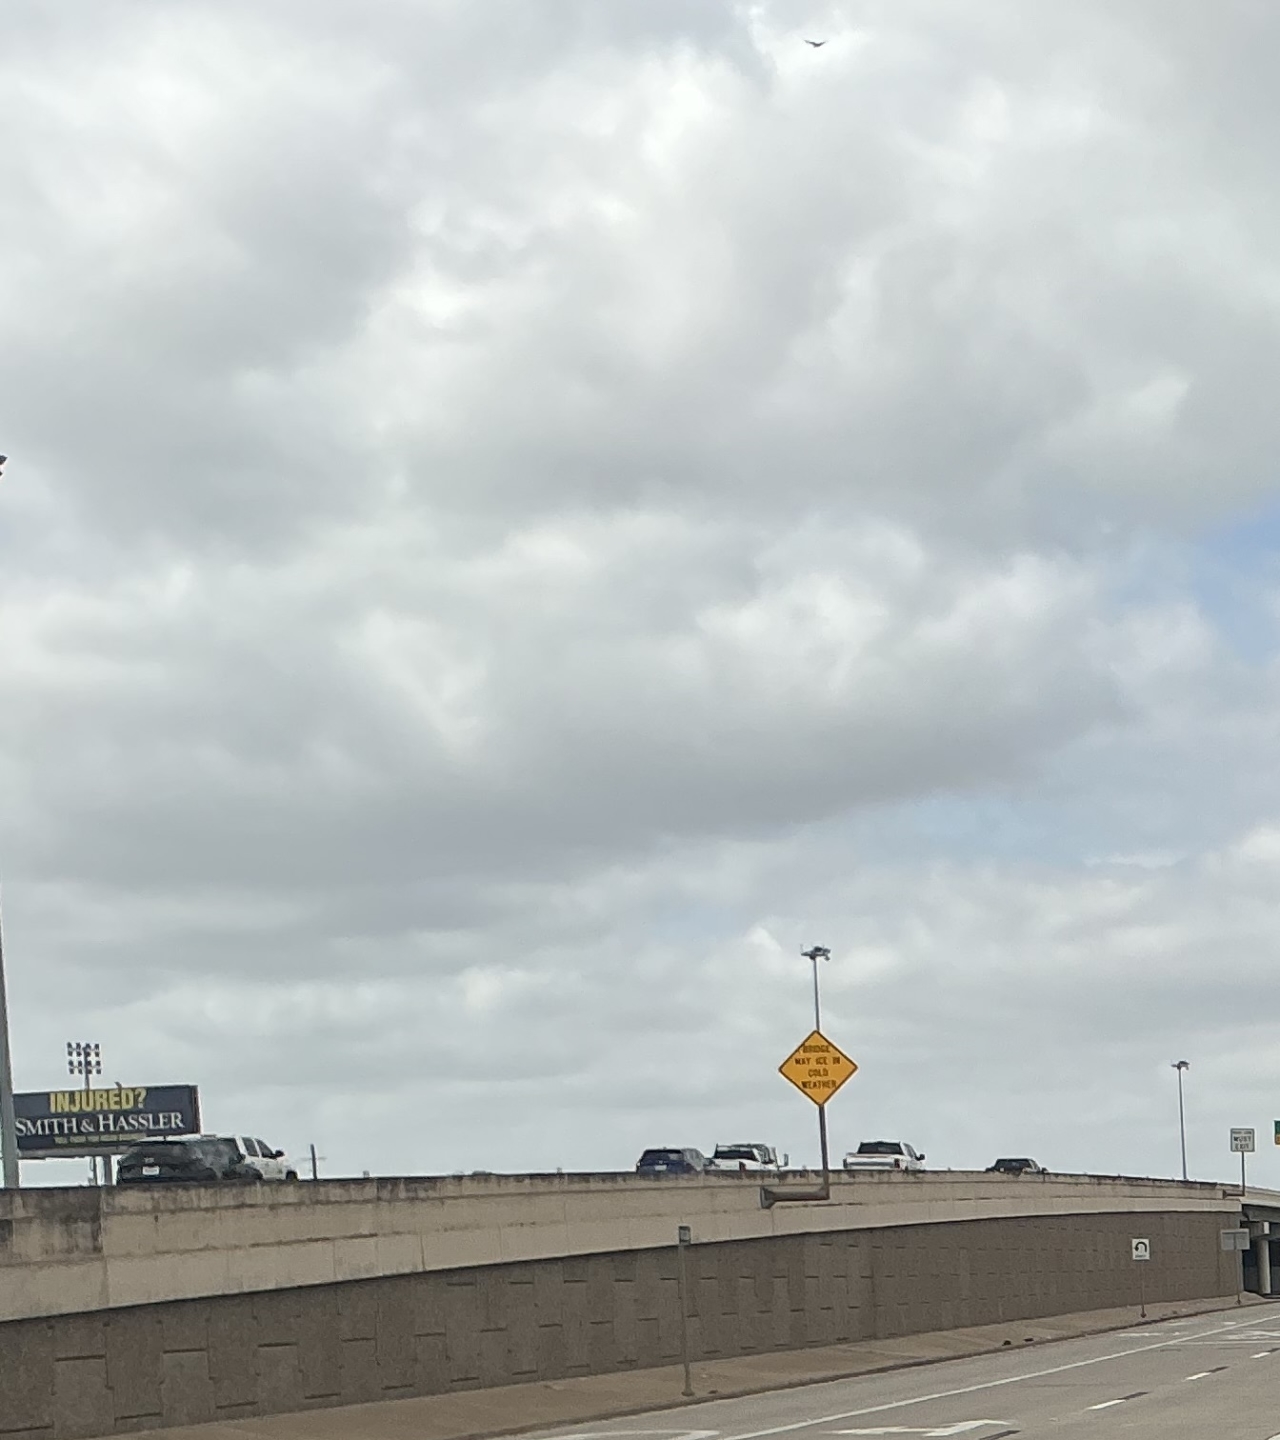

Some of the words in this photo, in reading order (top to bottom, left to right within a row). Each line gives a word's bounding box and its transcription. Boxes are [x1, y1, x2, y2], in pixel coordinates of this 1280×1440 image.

[801, 1080, 837, 1089] WEATHER
[50, 1087, 147, 1114] INJURED?
[15, 1118, 78, 1136] SMITH
[80, 1119, 95, 1133] &
[98, 1112, 185, 1132] HASSLER
